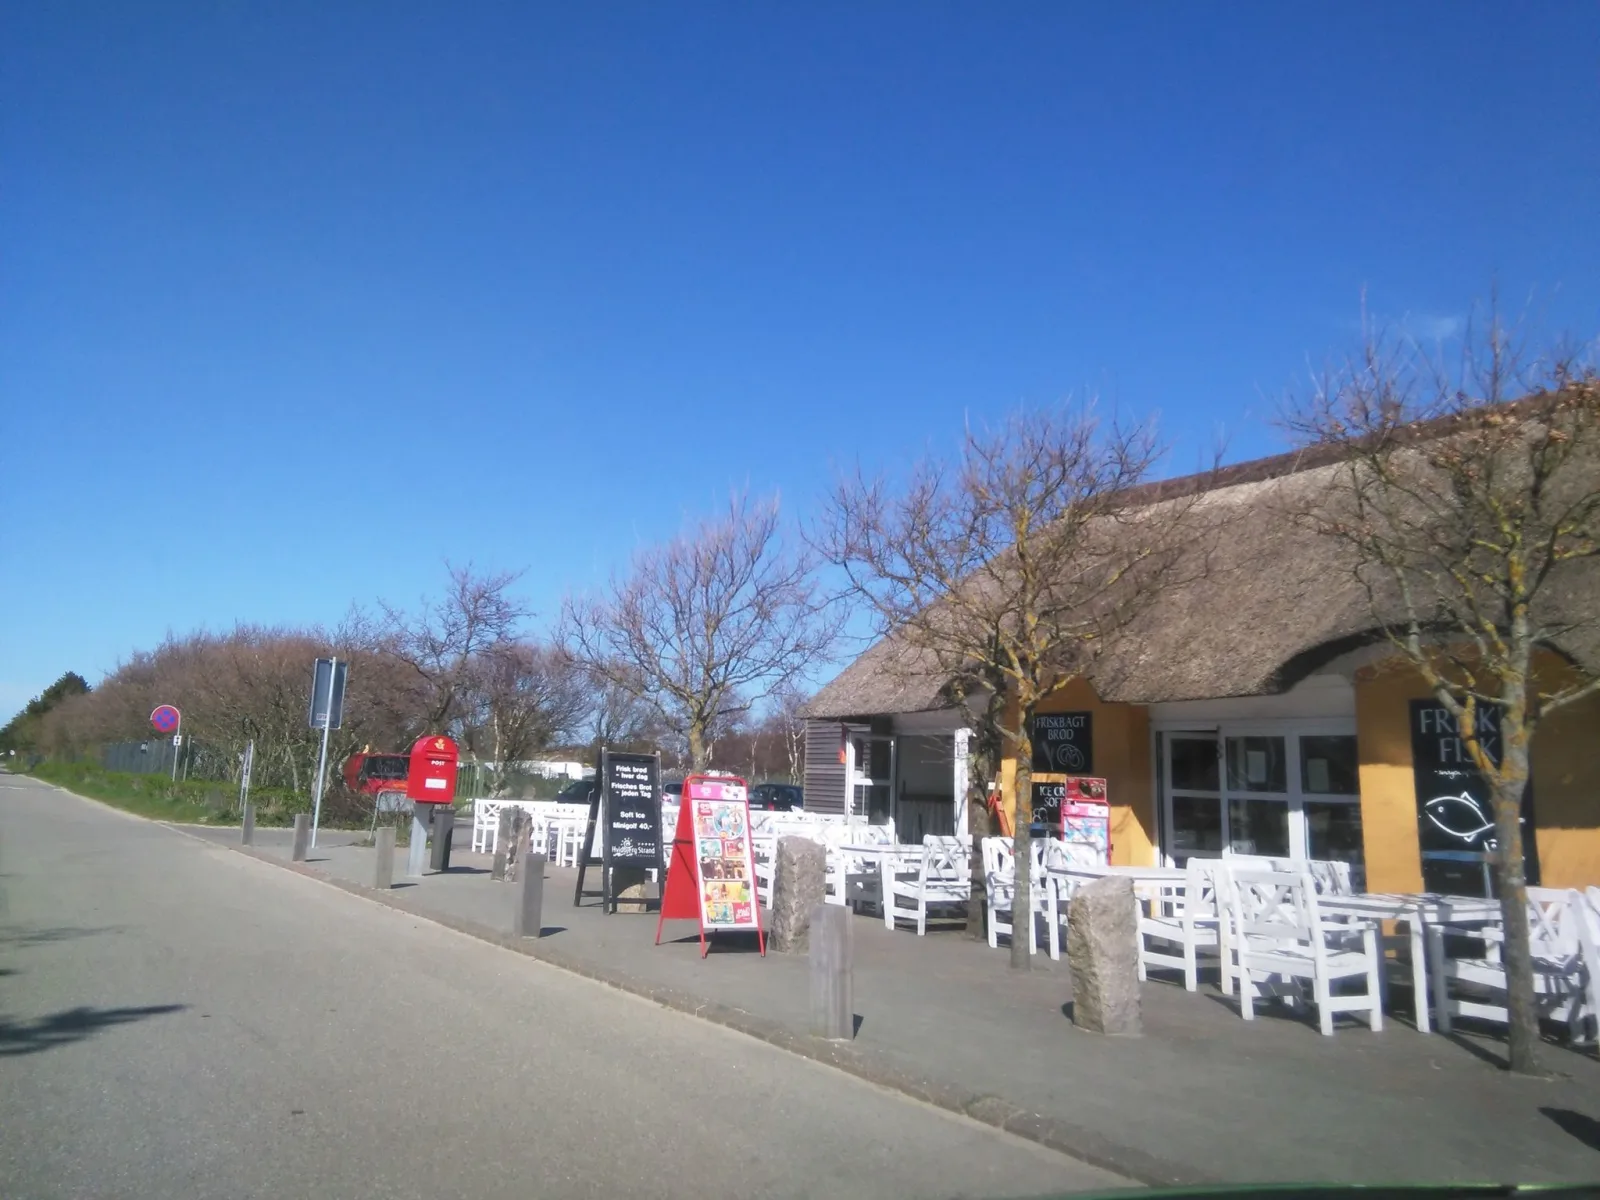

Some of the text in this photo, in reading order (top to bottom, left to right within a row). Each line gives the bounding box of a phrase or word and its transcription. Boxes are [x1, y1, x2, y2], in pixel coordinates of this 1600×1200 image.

[1036, 716, 1085, 728] FRISKBAGT
[611, 782, 637, 790] Frisches
[640, 790, 651, 798] Tag
[1040, 786, 1052, 796] ICE
[1053, 786, 1065, 797] CR
[612, 822, 637, 830] Minigolf
[638, 846, 655, 854] Strand
